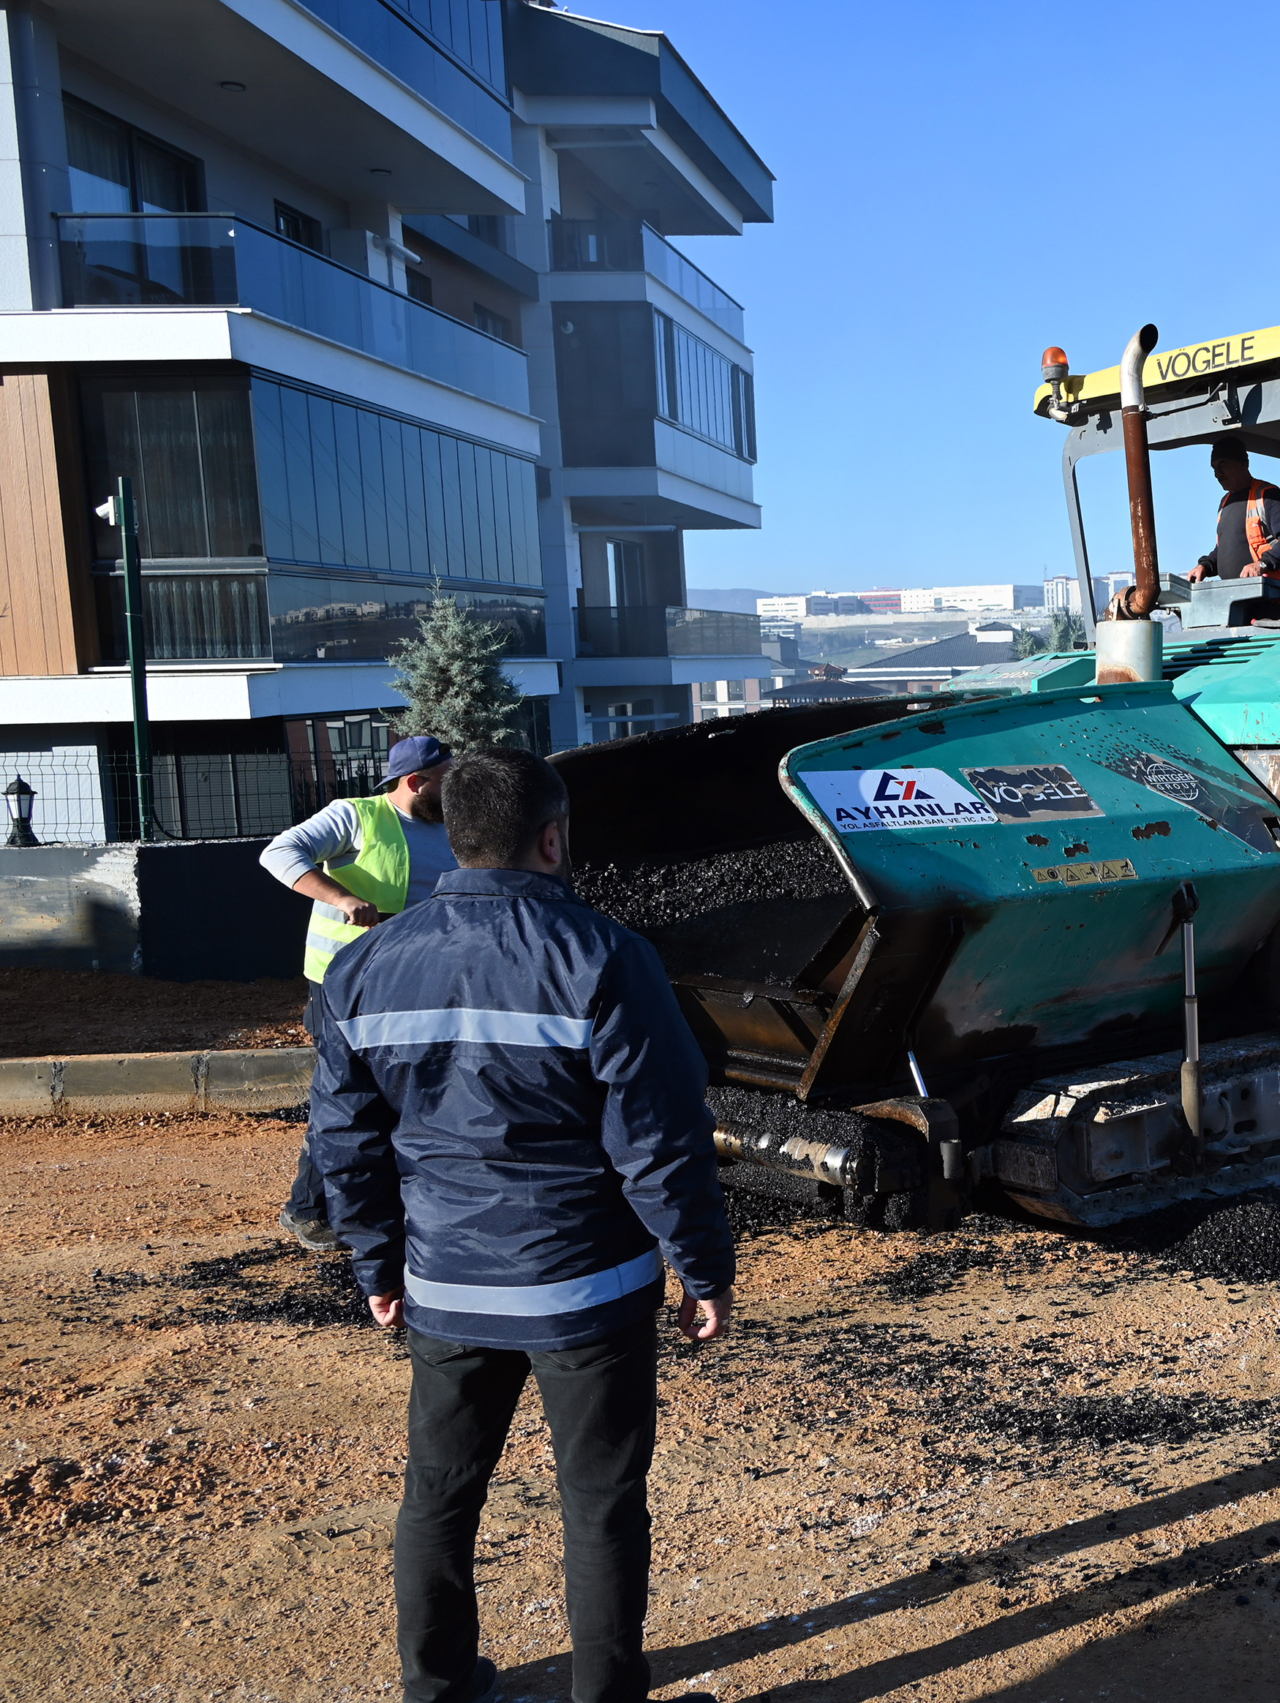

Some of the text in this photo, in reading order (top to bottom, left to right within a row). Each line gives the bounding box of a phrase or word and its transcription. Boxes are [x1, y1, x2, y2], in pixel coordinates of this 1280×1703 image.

[1157, 336, 1255, 381] VÖGELE
[1144, 773, 1195, 783] WIRTGEN
[1156, 782, 1197, 791] GROUP
[835, 801, 992, 822] AYHANLAR
[862, 819, 925, 829] ASFALTLAMA
